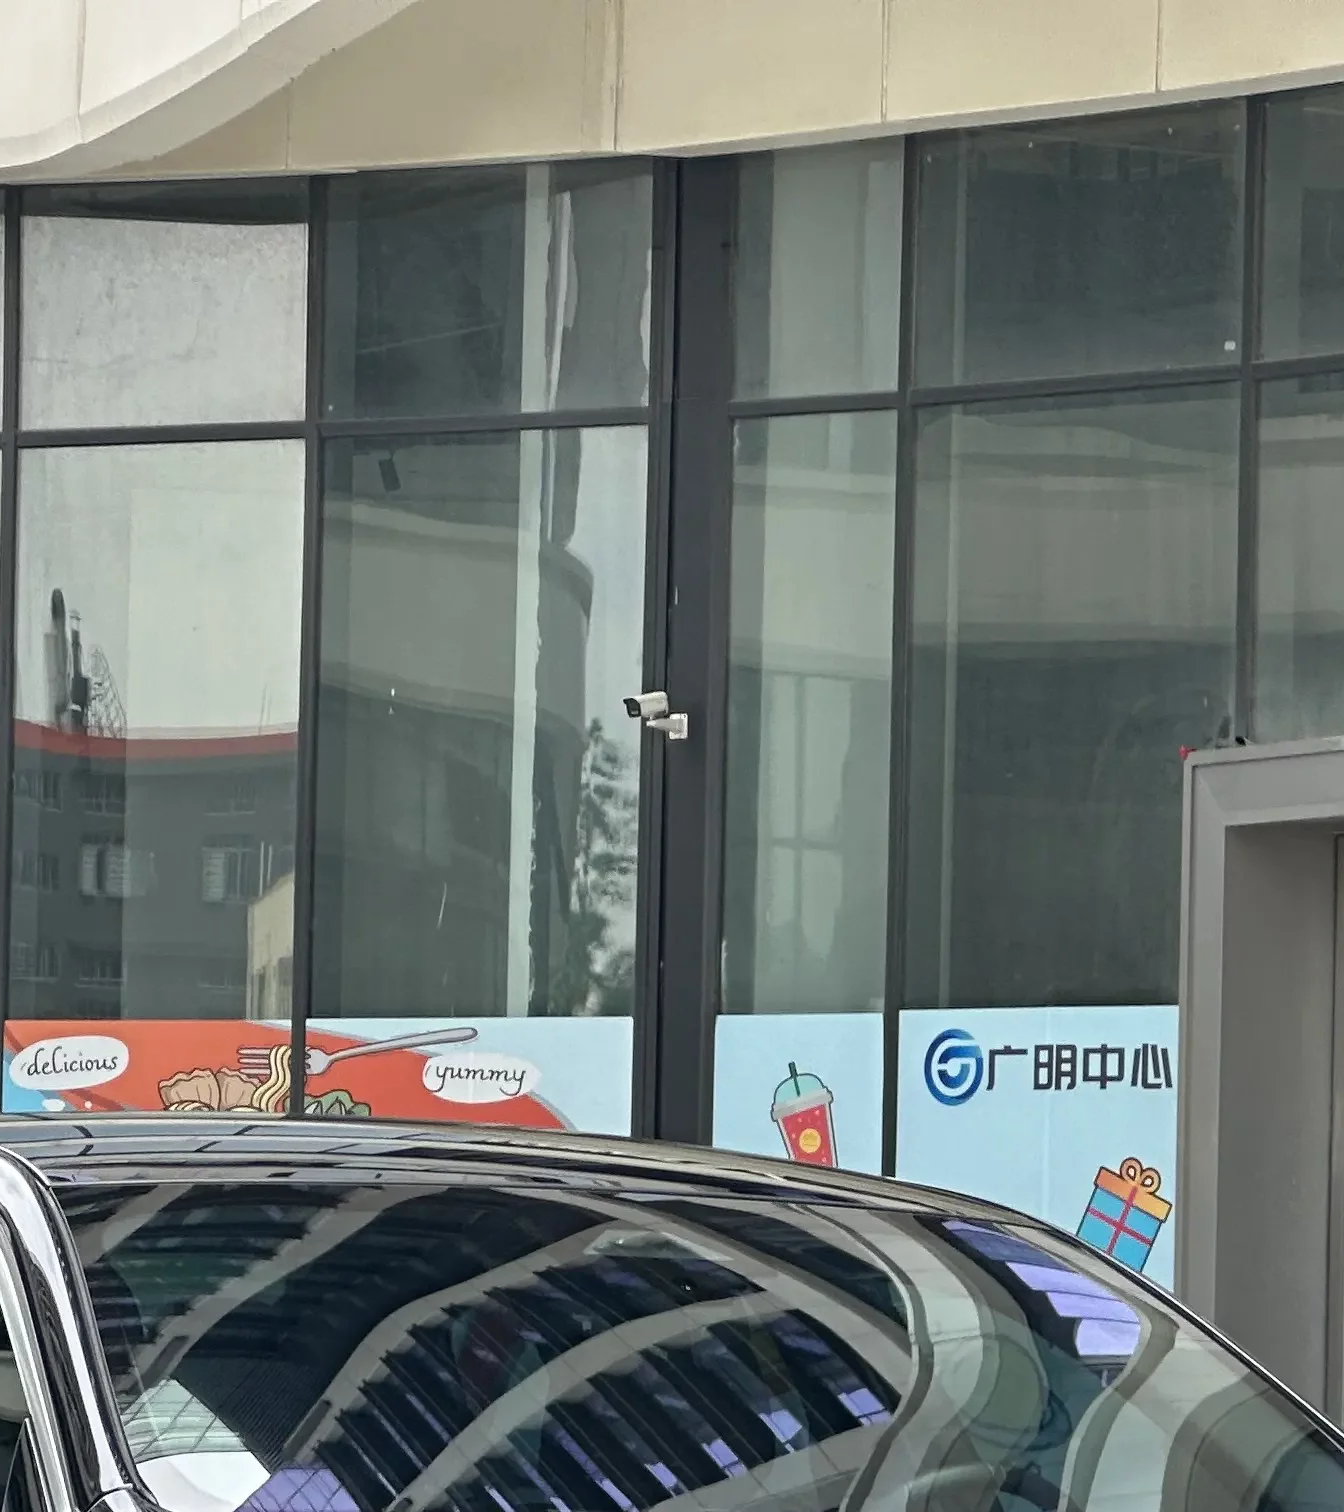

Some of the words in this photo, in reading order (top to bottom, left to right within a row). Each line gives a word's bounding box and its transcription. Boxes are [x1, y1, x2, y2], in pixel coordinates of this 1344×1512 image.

[27, 1045, 118, 1076] delicious
[986, 1043, 1173, 1091] 广明中心
[424, 1065, 526, 1096] yummy
